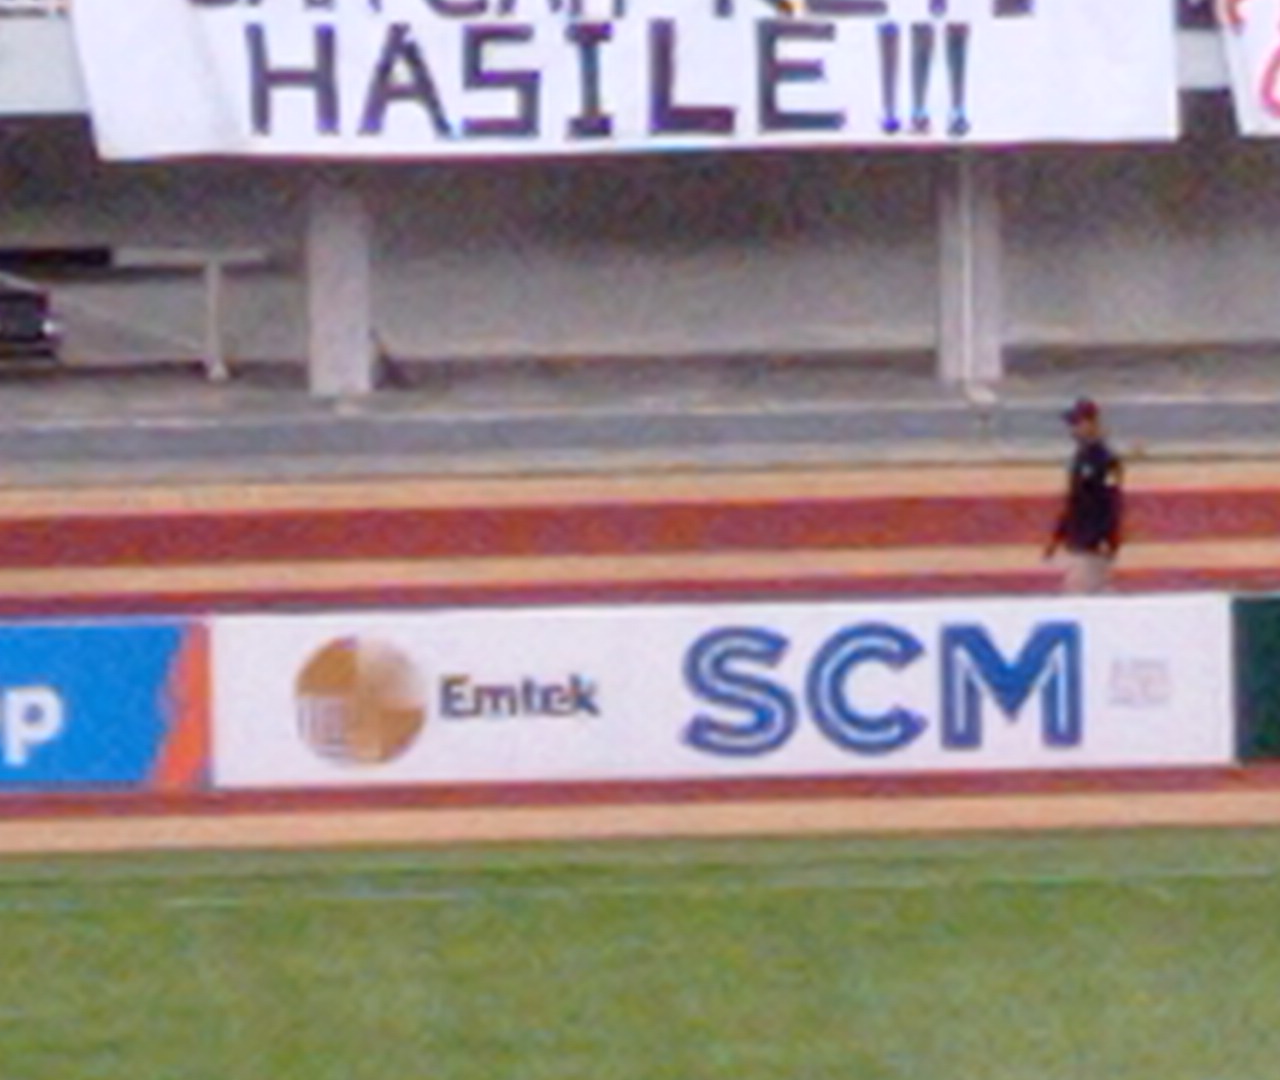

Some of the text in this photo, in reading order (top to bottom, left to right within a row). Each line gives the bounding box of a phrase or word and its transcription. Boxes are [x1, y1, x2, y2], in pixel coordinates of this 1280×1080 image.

[243, 18, 972, 138] HASILE!!!
[439, 673, 600, 720] Emtek
[682, 621, 1084, 758] SCM
